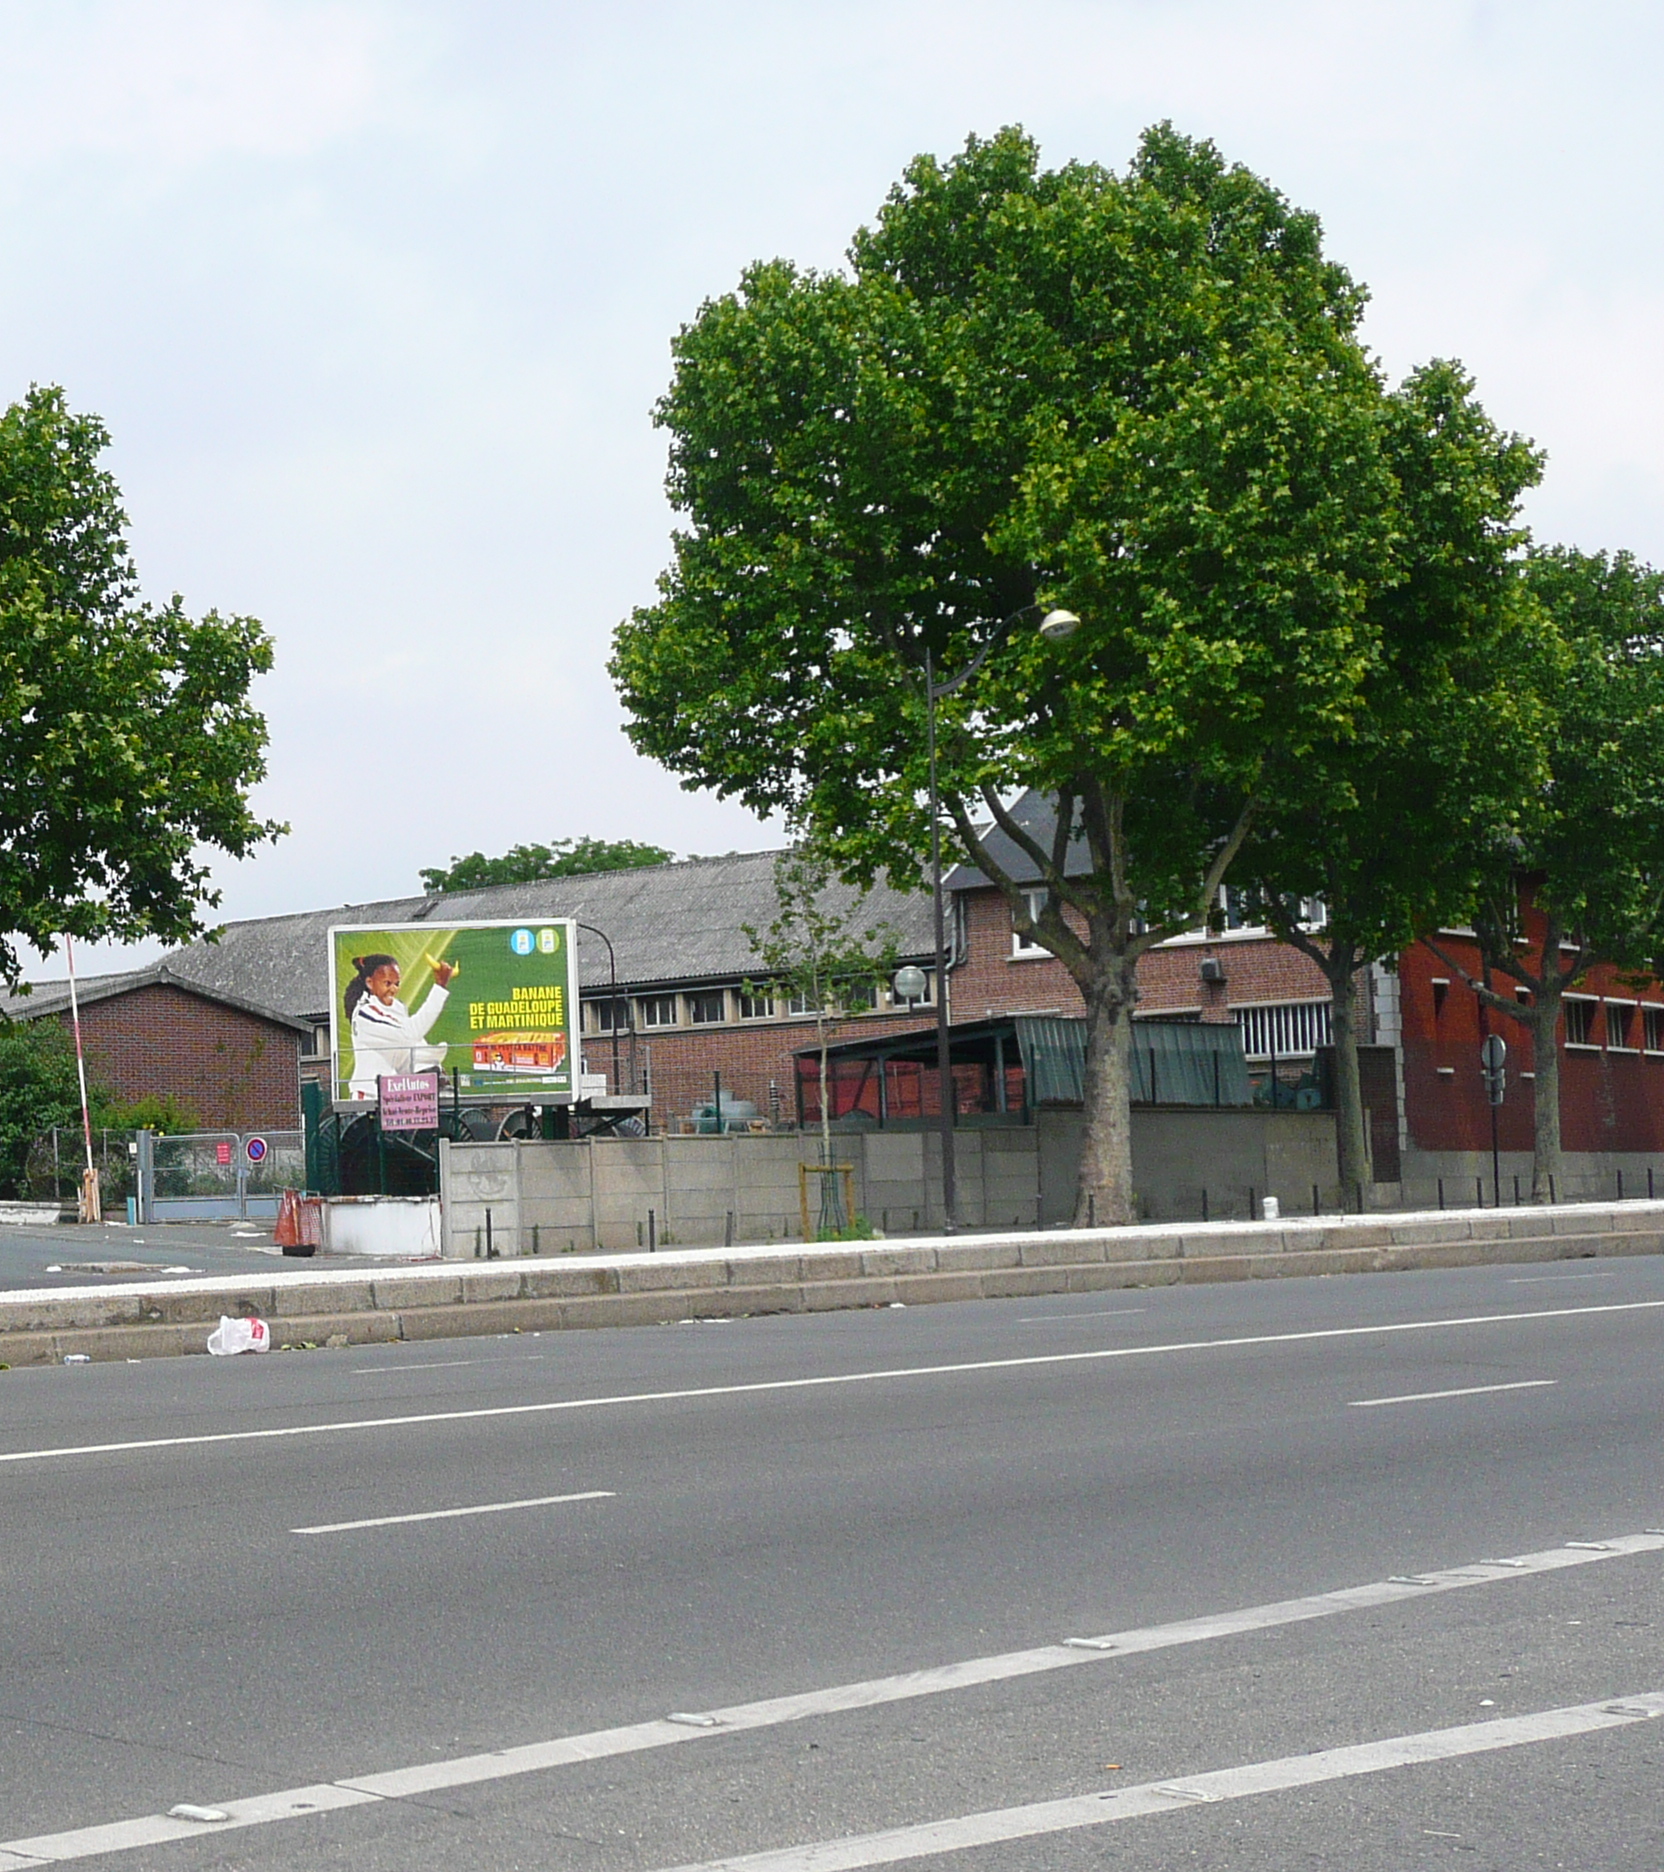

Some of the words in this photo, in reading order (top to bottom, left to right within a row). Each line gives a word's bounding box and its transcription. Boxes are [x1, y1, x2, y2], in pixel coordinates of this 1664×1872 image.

[512, 986, 562, 1000] BANANE
[469, 1003, 485, 1015] DE
[487, 1000, 563, 1014] GUADELOUPE
[470, 1016, 485, 1029] ET
[486, 1013, 563, 1028] MARTINIQUE
